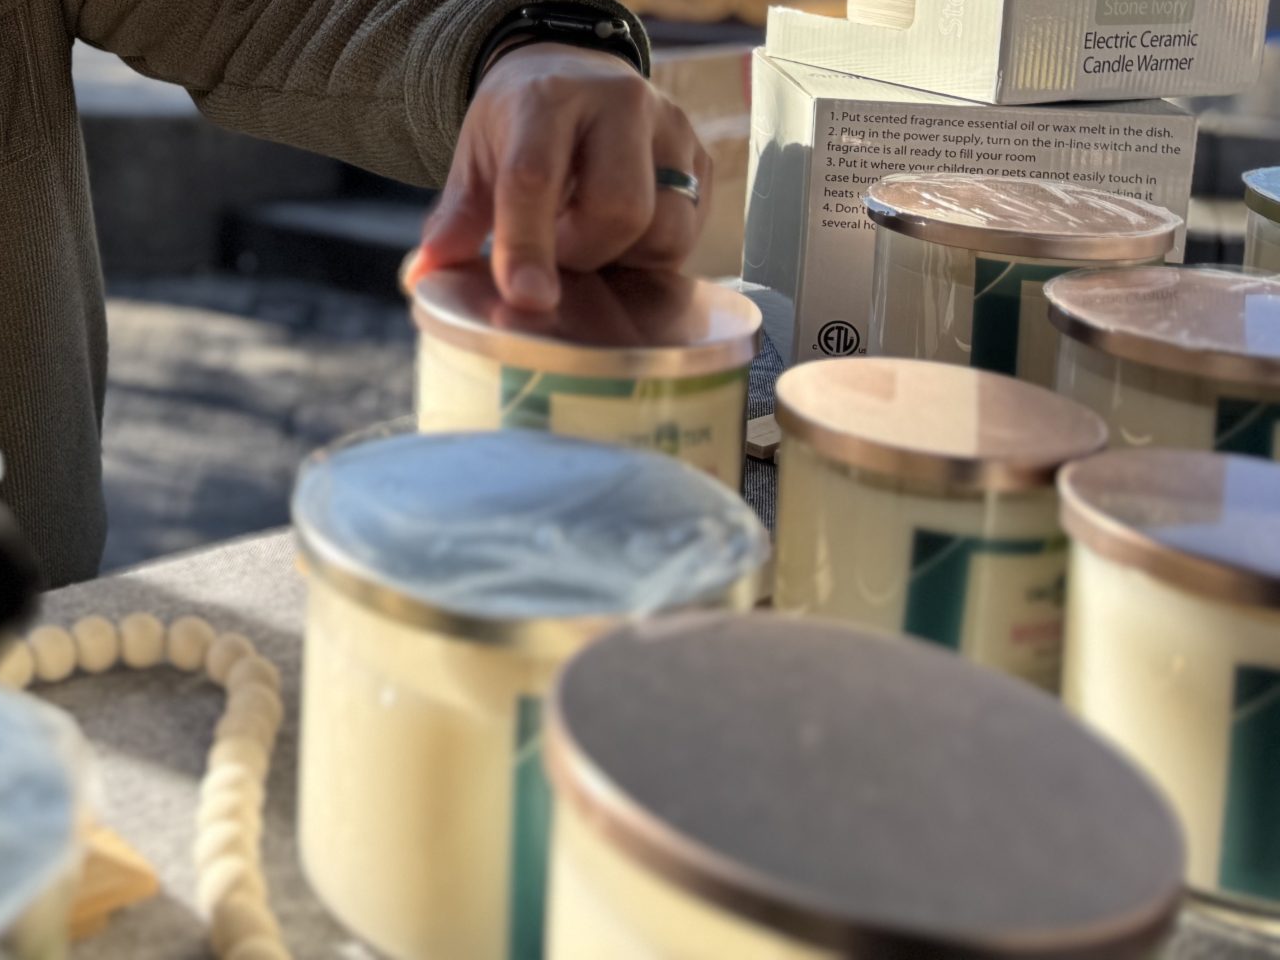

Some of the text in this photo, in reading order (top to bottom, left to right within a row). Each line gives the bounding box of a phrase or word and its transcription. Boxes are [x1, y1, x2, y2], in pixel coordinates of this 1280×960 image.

[1084, 29, 1199, 50] Electric Ceramic
[1083, 54, 1194, 74] Candle Warmer
[829, 111, 1174, 138] 1. Put scented fragrance essential oil or wax melt in the dish.
[828, 126, 1181, 155] 2. Plug in the power supply, turn on the in-line switch and the
[827, 141, 1036, 163] fragrance is all ready to fill your room
[824, 174, 850, 183] case
[825, 157, 836, 167] 3.
[838, 157, 857, 168] Put
[860, 158, 869, 169] it
[870, 160, 906, 171] where
[937, 163, 983, 175] children
[986, 167, 1000, 176] or
[1029, 170, 1070, 181] cannot
[1072, 171, 1106, 184] easily
[1108, 174, 1143, 185] touch
[1145, 174, 1157, 185] in
[823, 187, 854, 198] heats
[1145, 189, 1153, 201] it
[822, 203, 867, 214] 4. Don't
[821, 218, 861, 230] several
